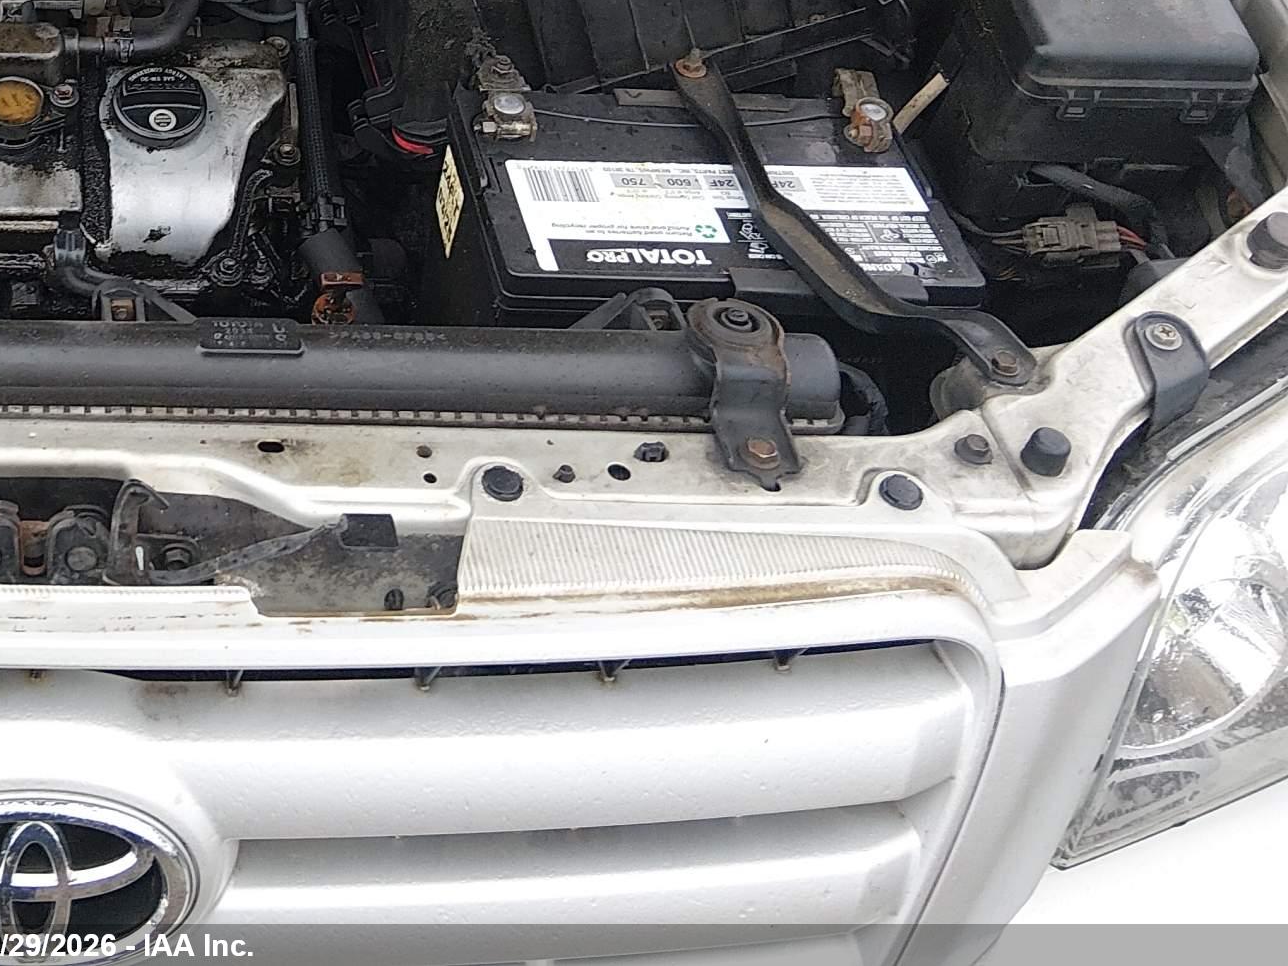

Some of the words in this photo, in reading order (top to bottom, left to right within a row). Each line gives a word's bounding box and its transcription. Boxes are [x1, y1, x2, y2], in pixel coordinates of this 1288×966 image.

[621, 177, 647, 186] 750
[709, 179, 734, 187] 24F
[586, 248, 712, 265] TOTALPRO
